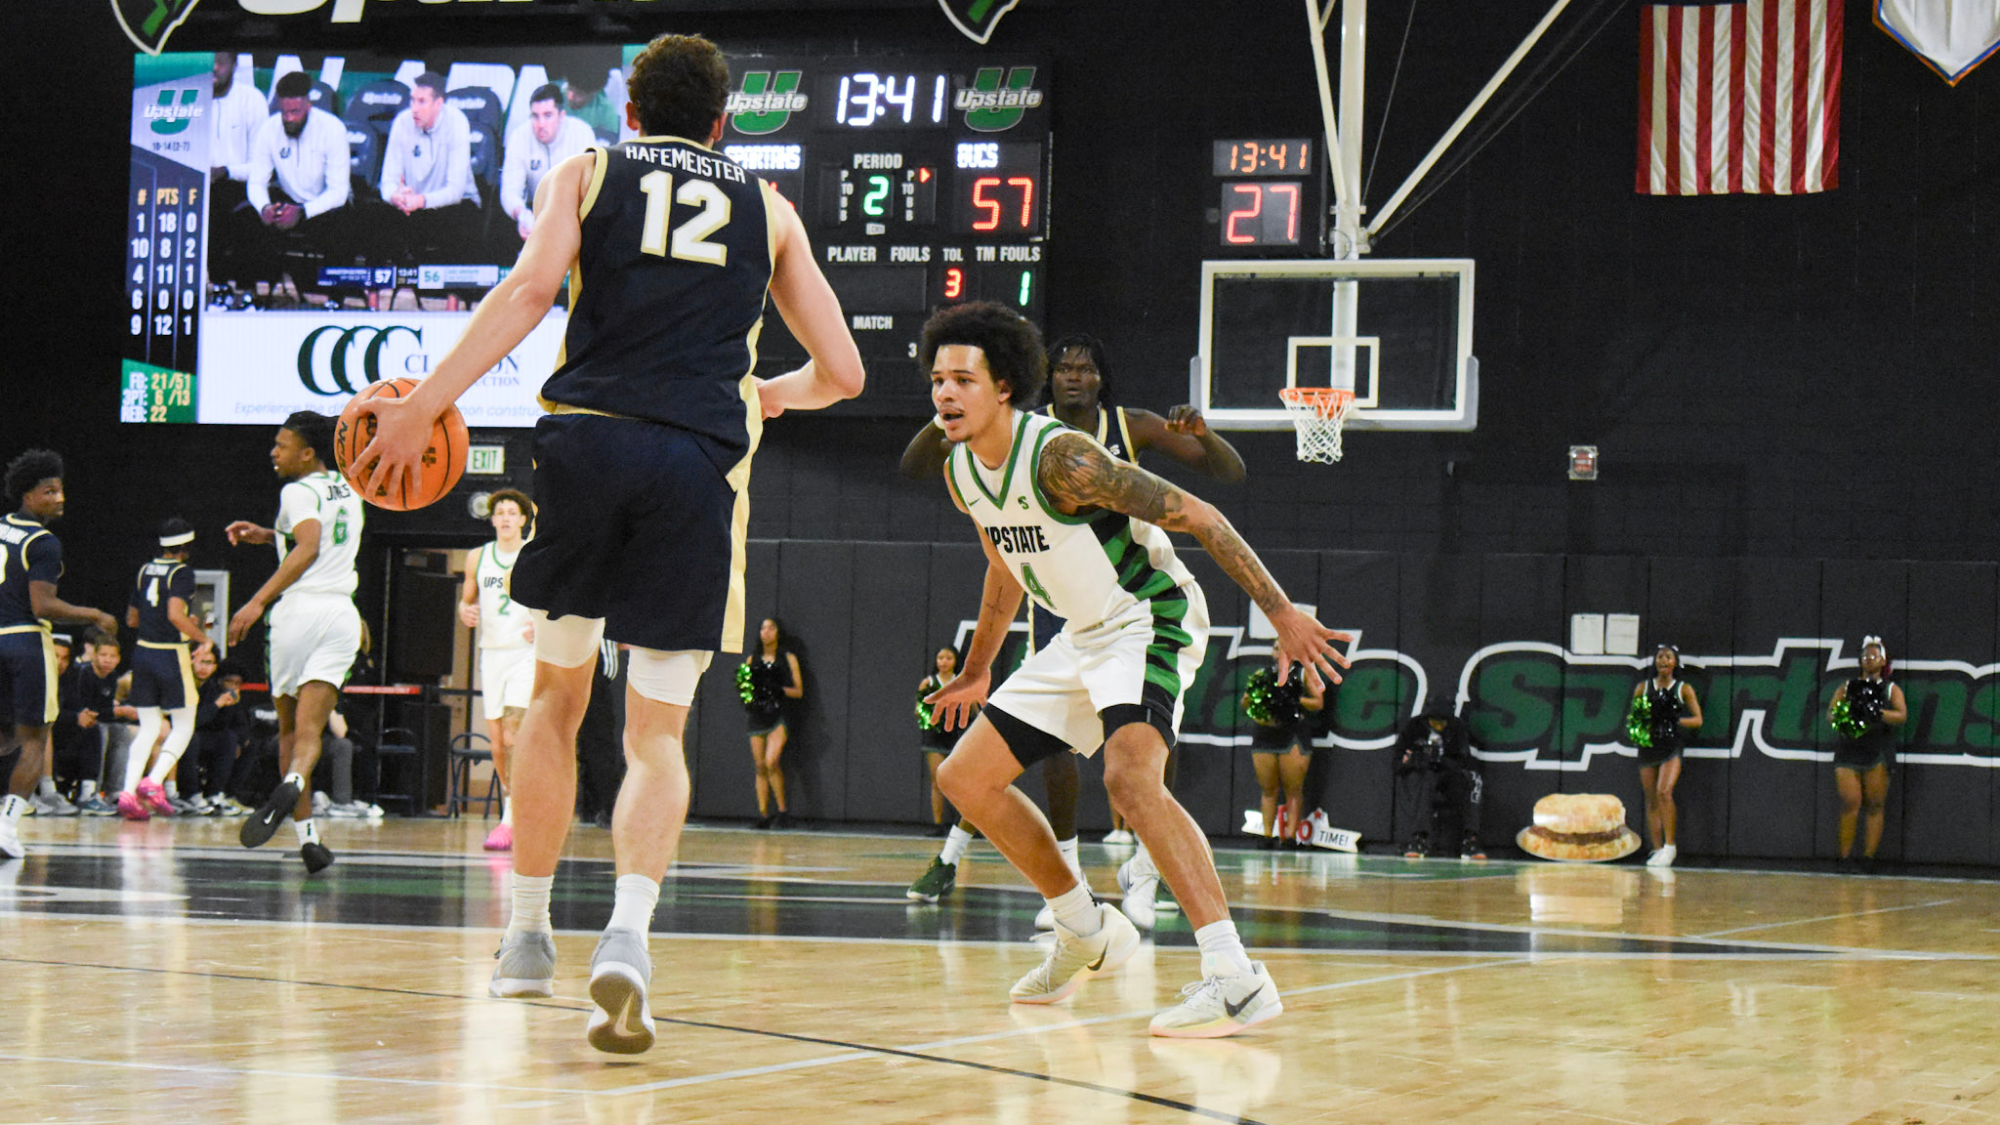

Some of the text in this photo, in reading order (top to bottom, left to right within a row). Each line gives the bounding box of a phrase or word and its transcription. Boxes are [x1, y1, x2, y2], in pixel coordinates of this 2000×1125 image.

[725, 92, 808, 112] Upstate
[837, 73, 945, 127] 13:41
[954, 87, 1043, 110] Upstate
[144, 106, 203, 122] Upstate
[625, 146, 746, 184] HAFEMEISTER
[724, 145, 801, 169] SPARTANS
[854, 153, 903, 170] PERIOD
[957, 143, 998, 168] BUCS
[1230, 142, 1308, 173] 13:41
[156, 188, 179, 205] PTS
[188, 188, 197, 205] F
[863, 175, 889, 216] 2
[973, 178, 1033, 230] 57
[137, 213, 197, 233] 1 18 0
[640, 170, 731, 267] 12
[1227, 185, 1298, 243] 27
[131, 238, 196, 258] 10 8 2
[827, 246, 931, 262] PLAYER FOULS
[943, 249, 963, 261] TOL
[976, 246, 1041, 262] TM FOULS
[132, 264, 194, 284] 4 11 1
[375, 269, 392, 283] 57
[424, 271, 440, 283] 56
[944, 268, 962, 298] 3
[1018, 271, 1031, 306] 1
[132, 289, 194, 310] 6 0 0
[130, 315, 192, 335] 9 12 1
[853, 316, 893, 330] MATCH
[150, 405, 167, 422] 22
[472, 449, 498, 470] EXIT
[332, 506, 350, 546] 6
[1021, 562, 1057, 610] 4
[498, 593, 510, 615] 2
[1319, 830, 1349, 847] TIME!
